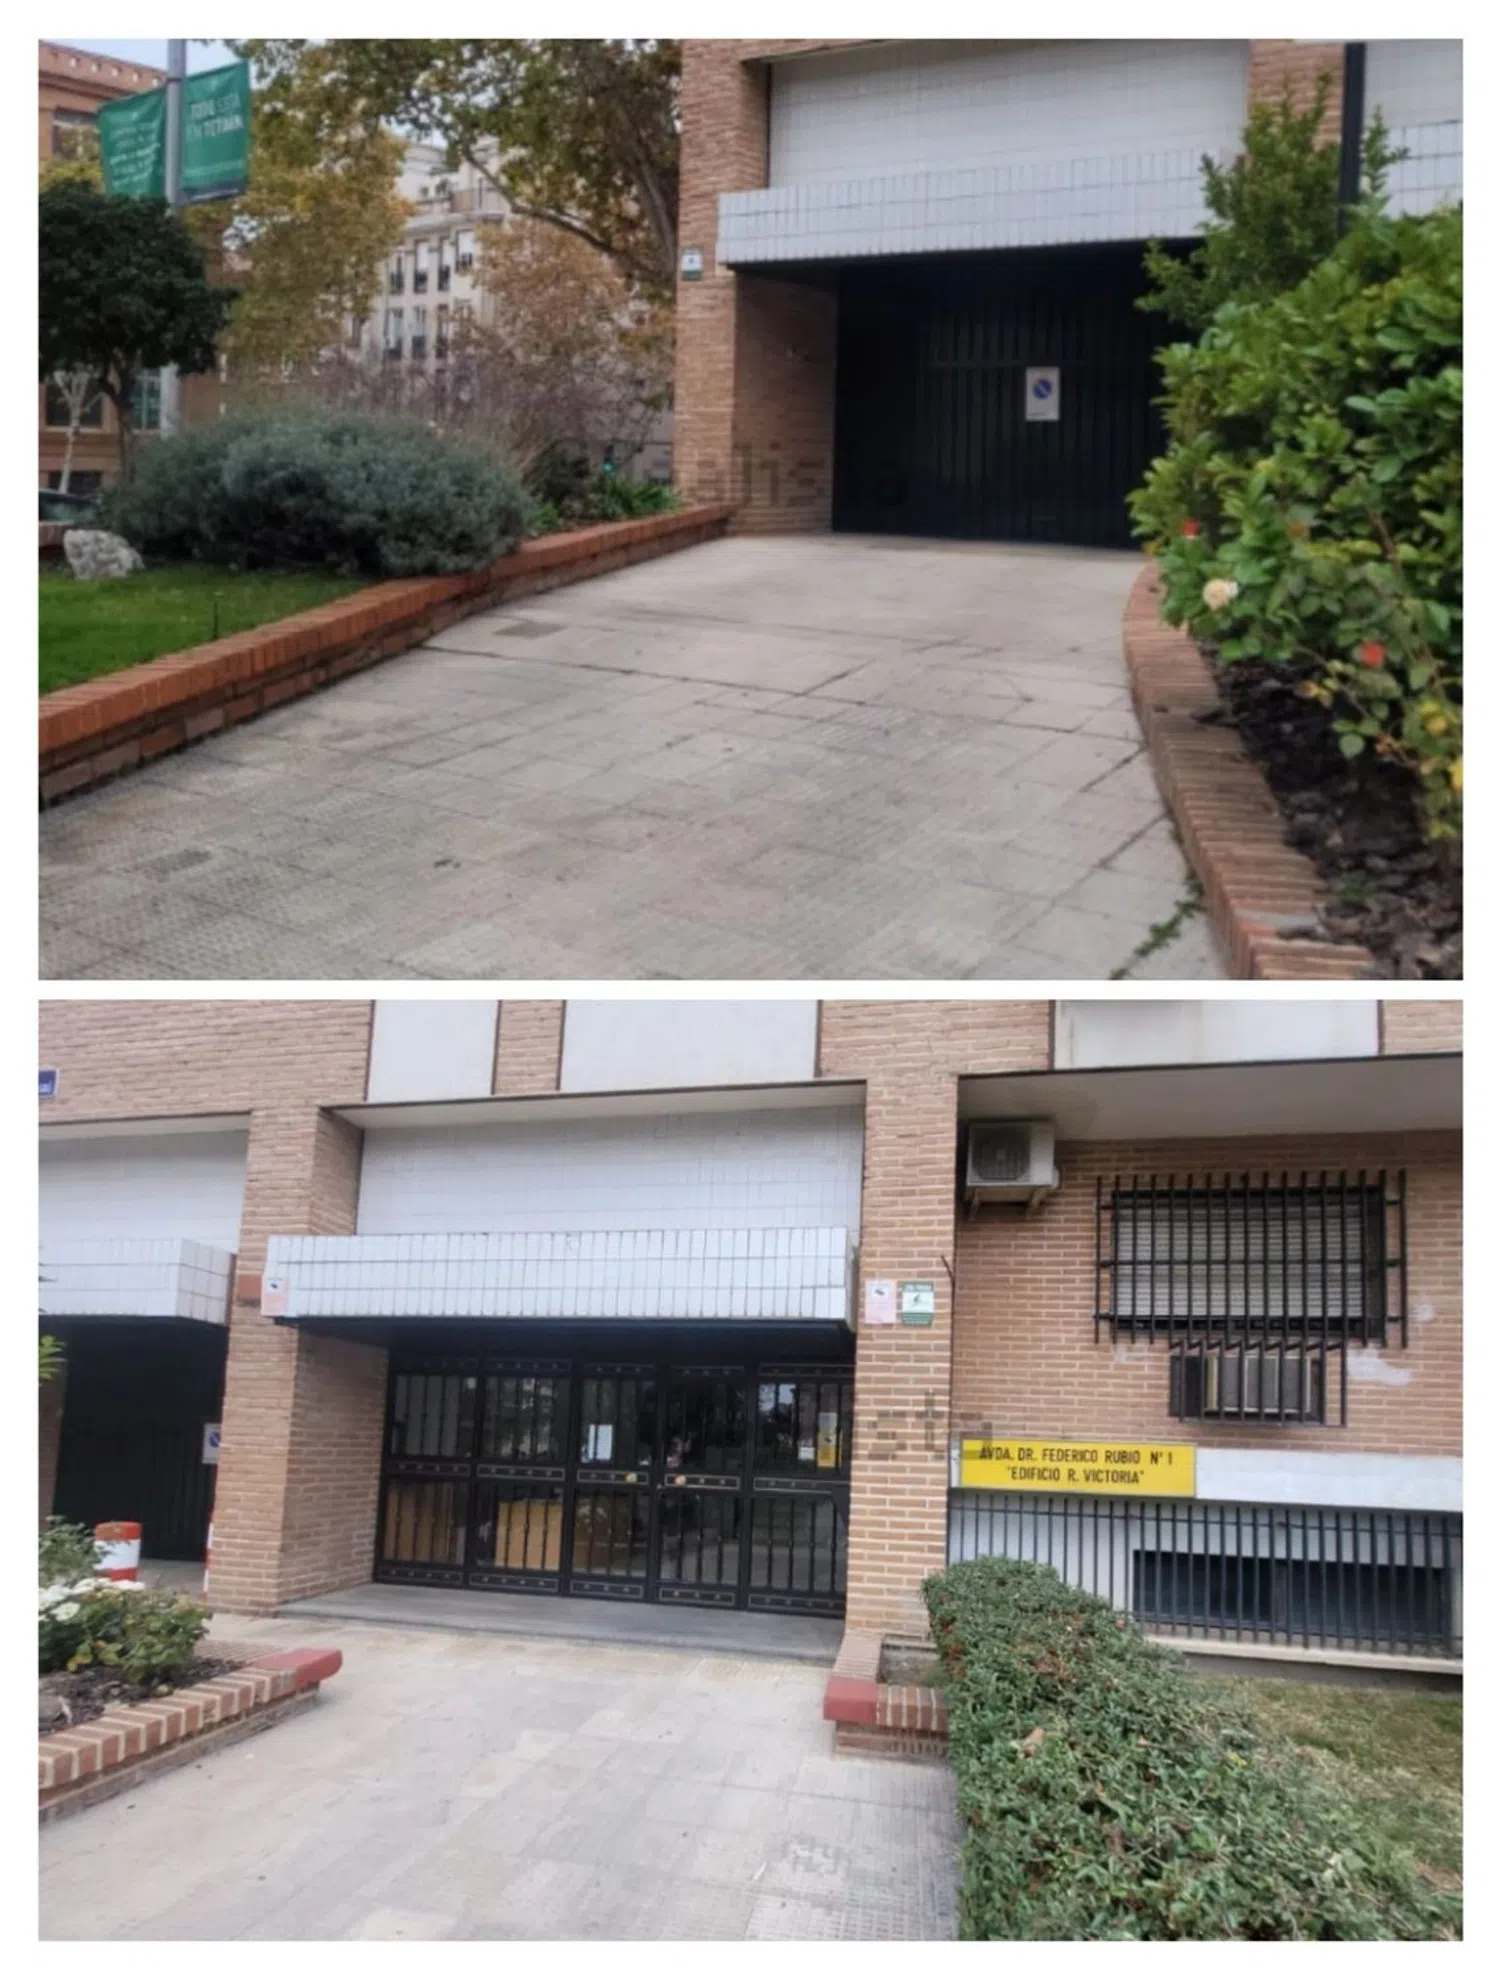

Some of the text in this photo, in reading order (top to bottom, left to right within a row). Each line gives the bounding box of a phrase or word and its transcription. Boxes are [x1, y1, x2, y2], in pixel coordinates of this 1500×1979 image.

[979, 1446, 1014, 1461] AVDA.
[1017, 1446, 1037, 1461] DR.
[1042, 1447, 1098, 1463] FEDERICO
[1104, 1449, 1140, 1464] RUBIO
[1067, 1468, 1080, 1483] R.
